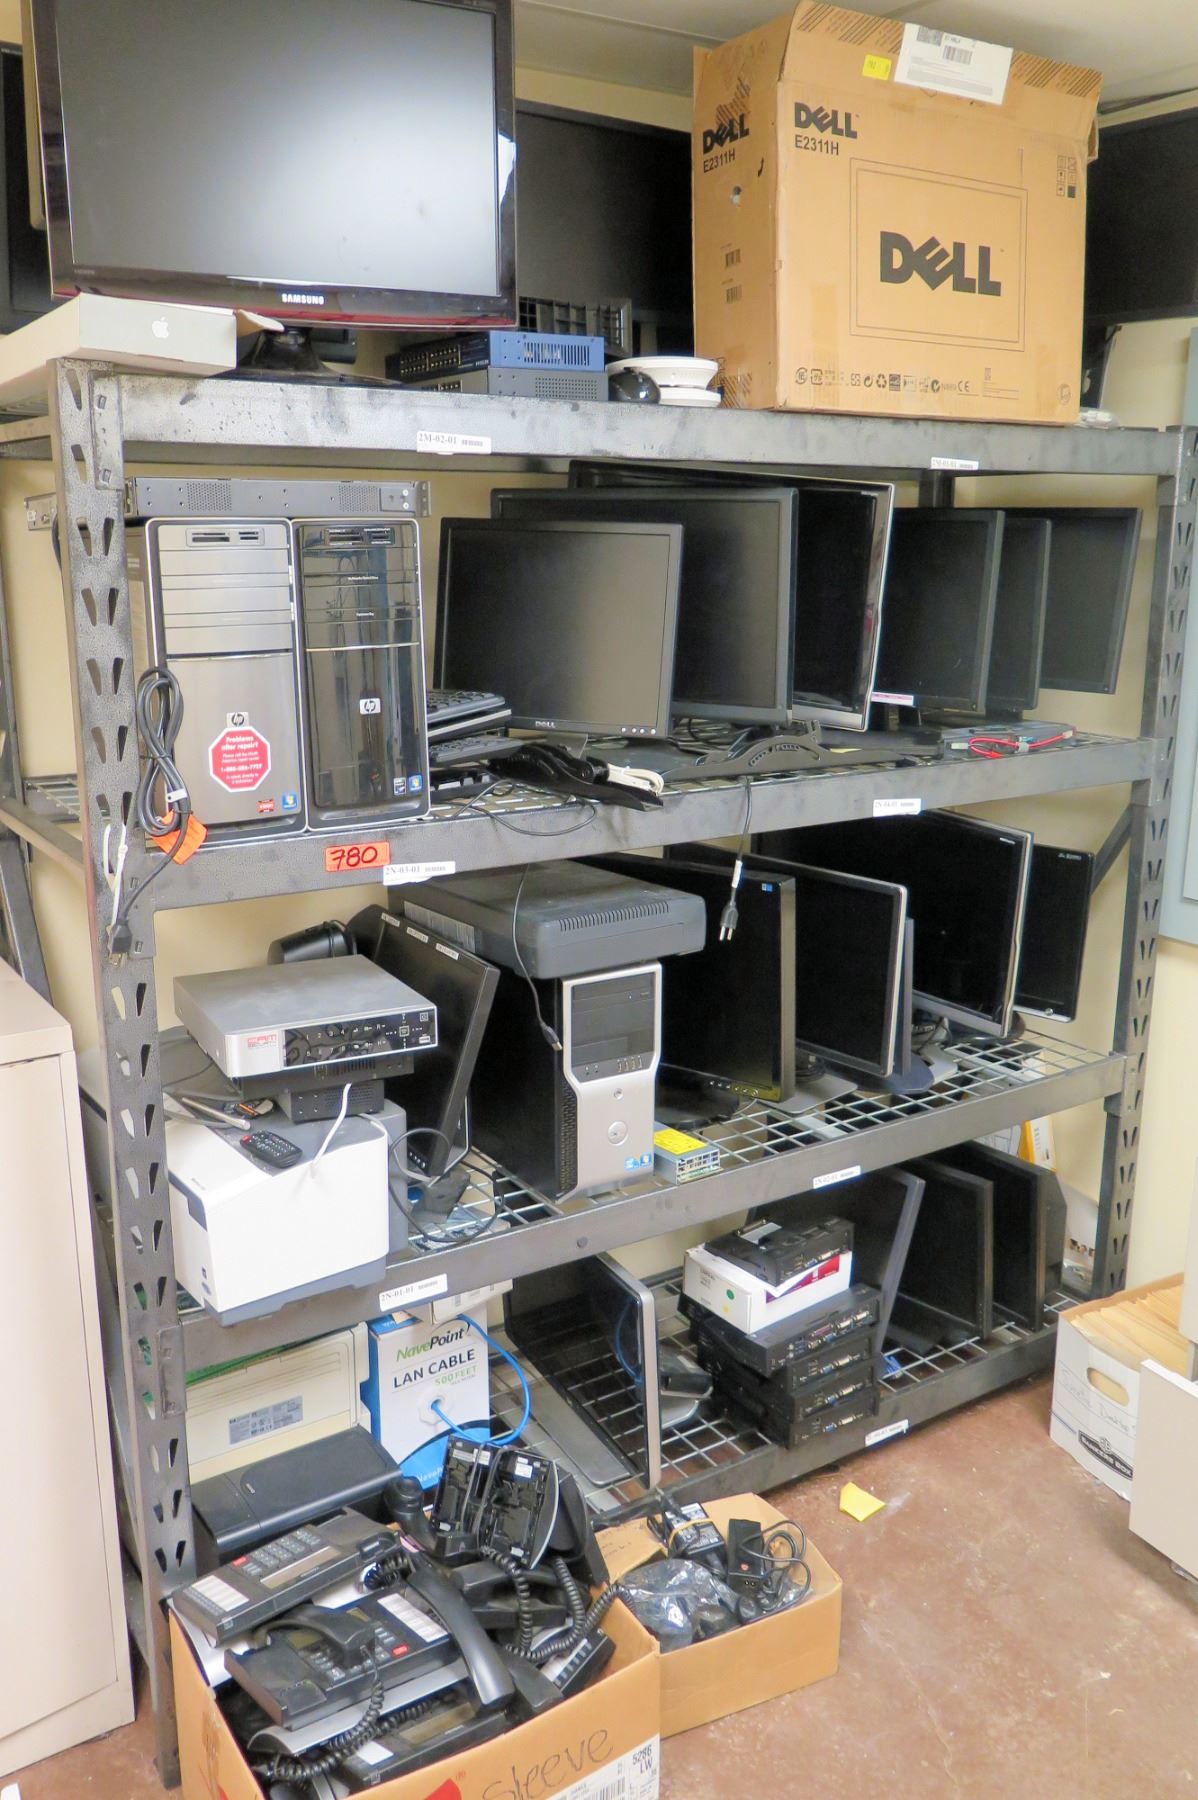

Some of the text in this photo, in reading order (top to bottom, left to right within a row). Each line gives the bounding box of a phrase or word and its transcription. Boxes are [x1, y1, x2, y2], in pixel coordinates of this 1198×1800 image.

[702, 112, 750, 155] DELL
[794, 101, 858, 139] DELL
[795, 134, 839, 156] E2311H
[703, 147, 736, 174] E2311H
[880, 230, 1002, 297] DELL
[281, 292, 325, 305] SAMSUNG
[535, 720, 557, 729] DELL
[330, 846, 378, 870] 780
[396, 1326, 465, 1362] NavePoint
[393, 1367, 424, 1389] LAN
[428, 1348, 476, 1375] CABLE
[435, 1373, 455, 1387] 500
